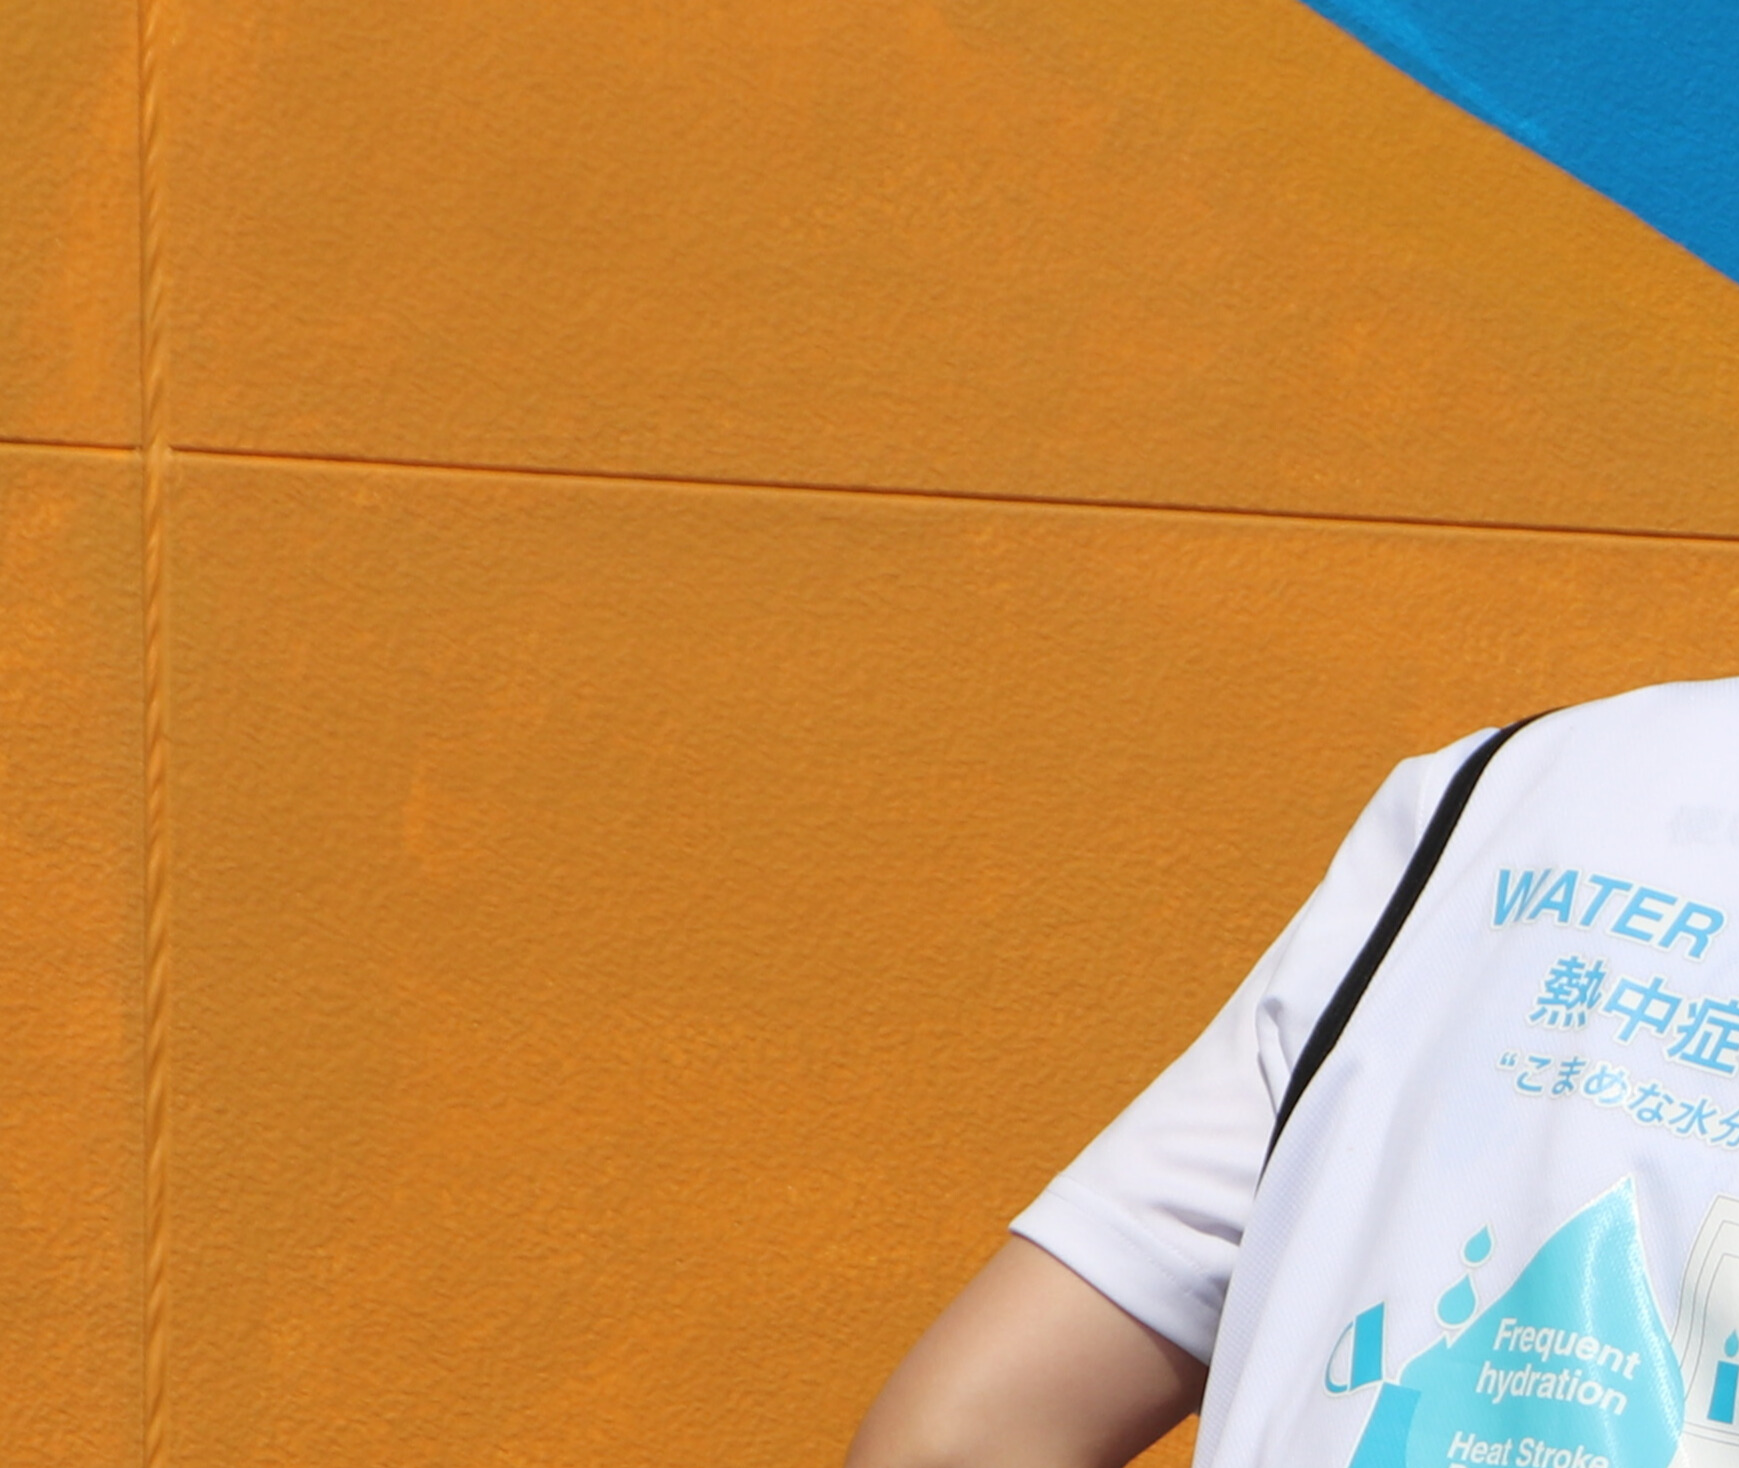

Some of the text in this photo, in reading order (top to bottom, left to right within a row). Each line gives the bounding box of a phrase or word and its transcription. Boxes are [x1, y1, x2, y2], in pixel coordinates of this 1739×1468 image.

[1493, 868, 1724, 958] WATER
[1493, 1317, 1641, 1380] Frequent
[1476, 1360, 1628, 1416] hydration
[1446, 1431, 1513, 1466] Heat
